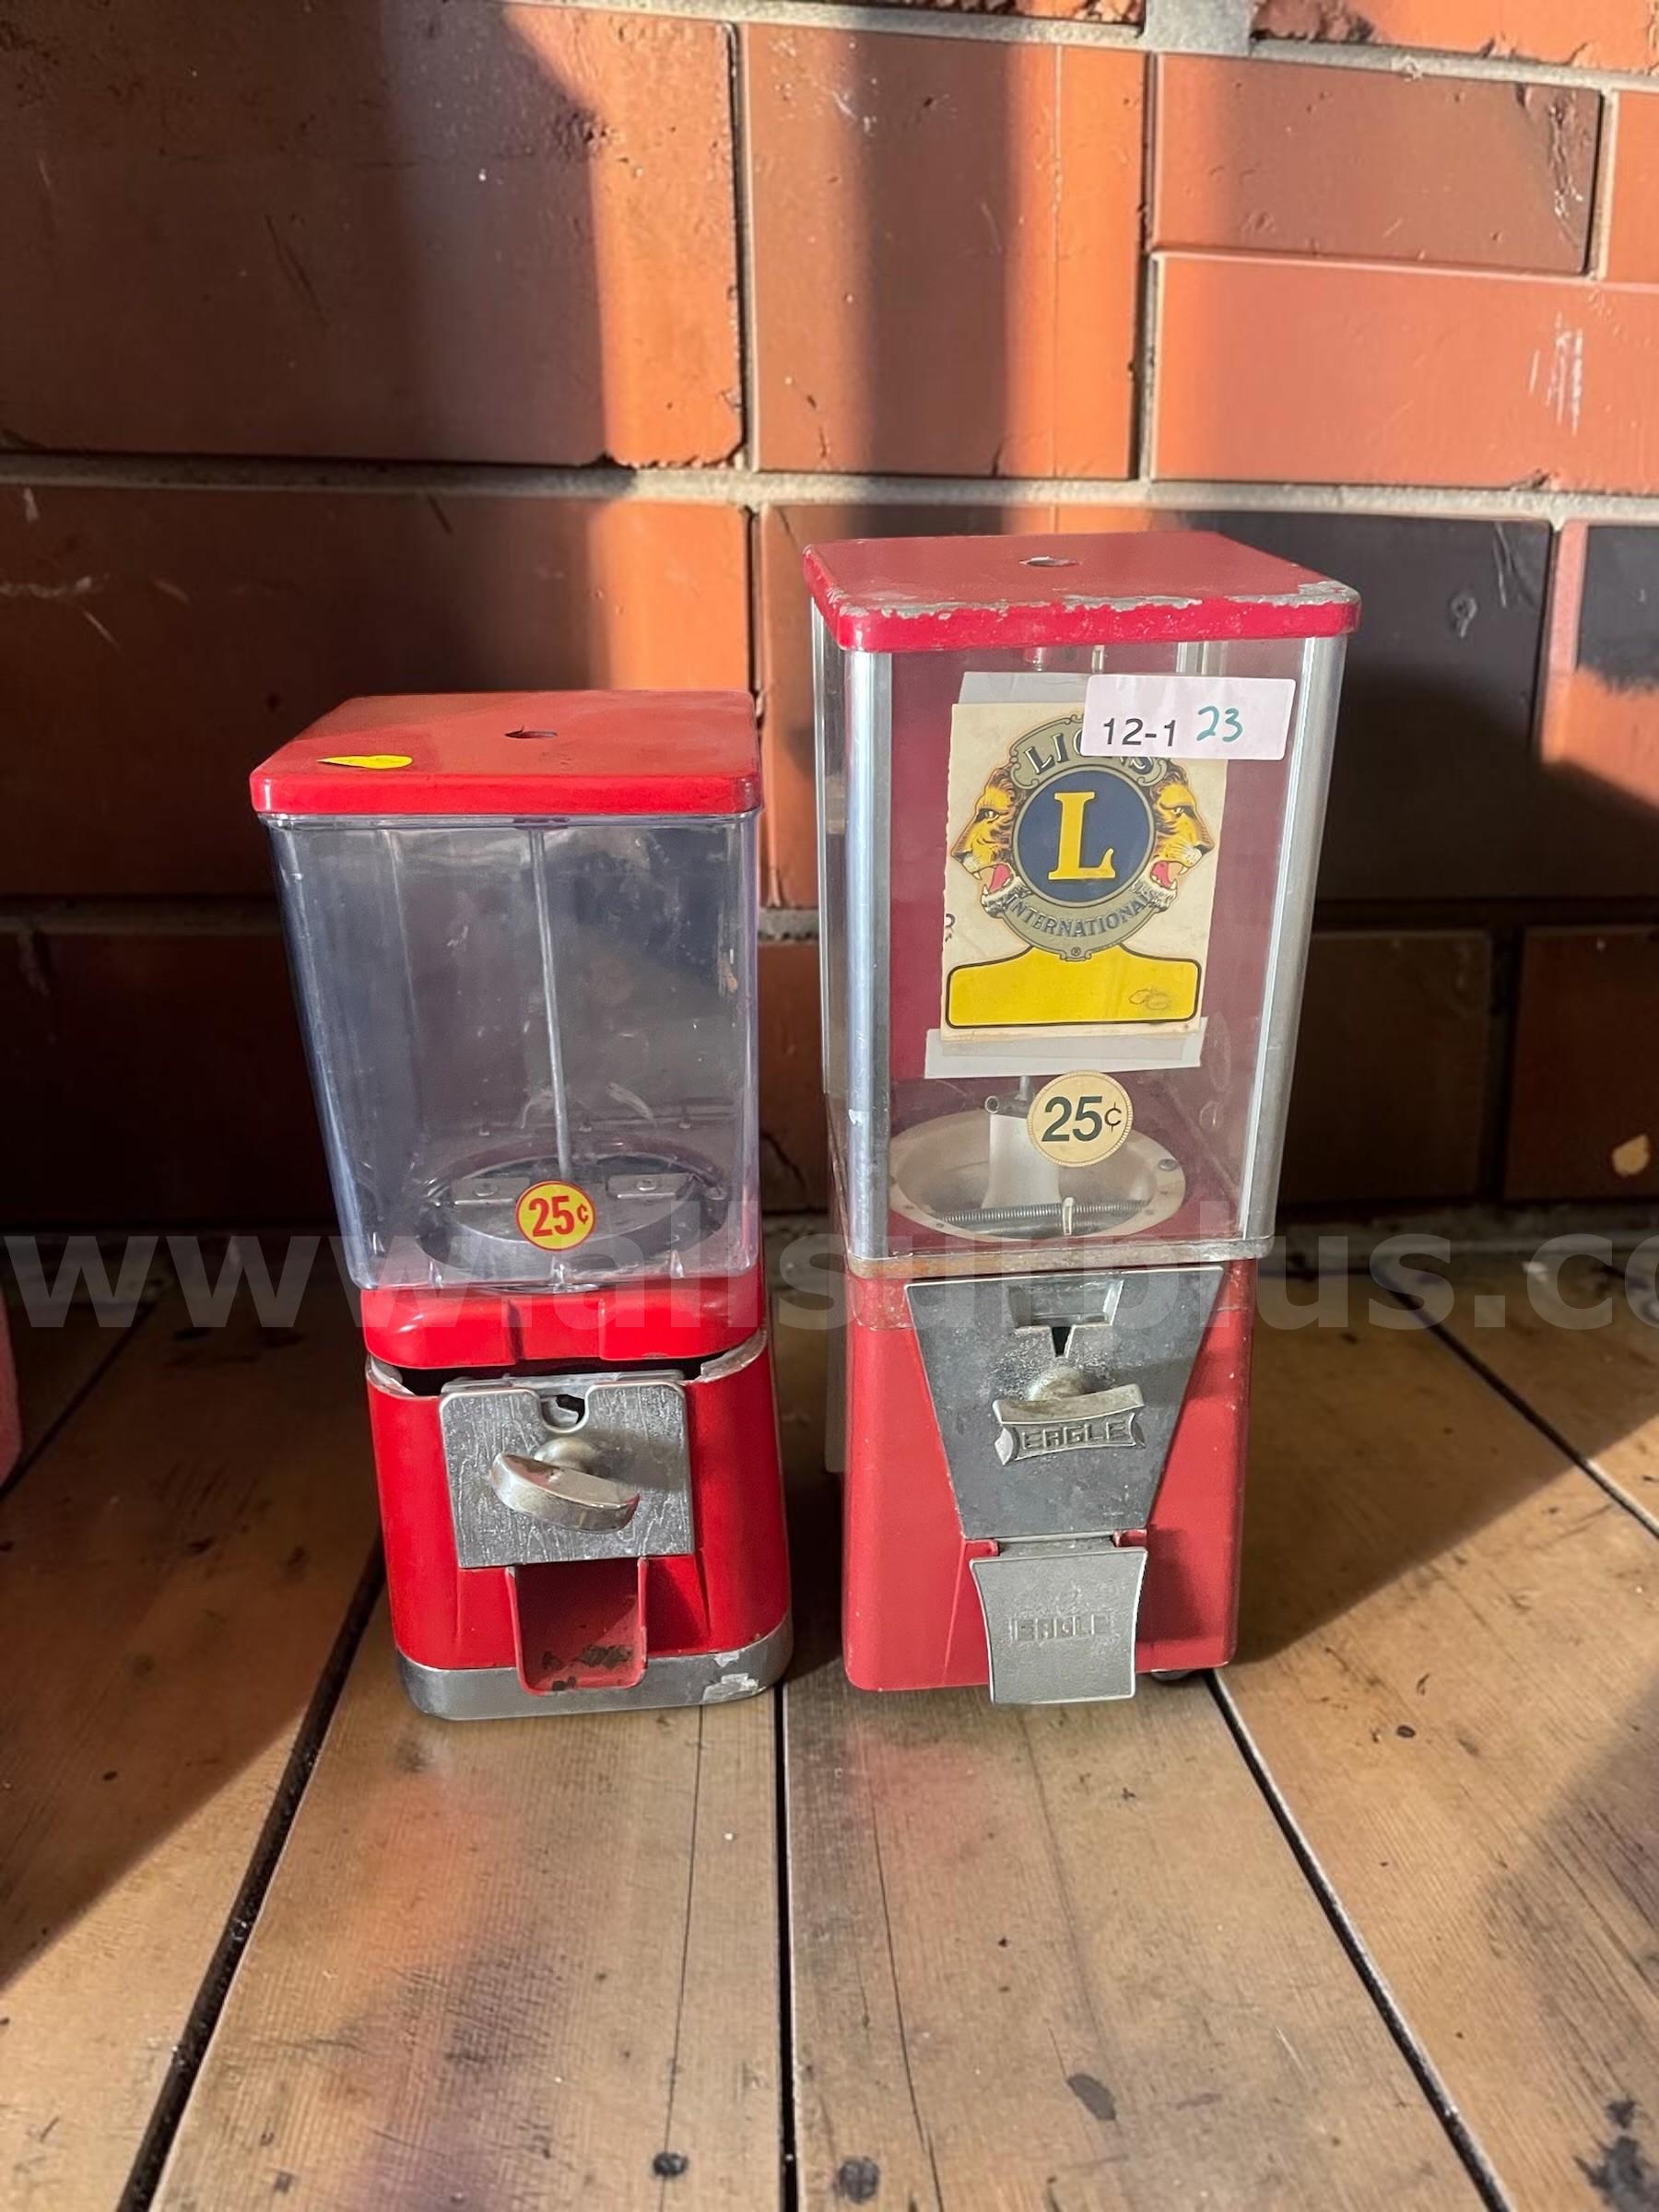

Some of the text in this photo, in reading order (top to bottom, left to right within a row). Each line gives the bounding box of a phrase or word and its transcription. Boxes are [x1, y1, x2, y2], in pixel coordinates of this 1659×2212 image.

[1103, 718, 1176, 747] 12-1
[1196, 705, 1243, 743] 23
[1024, 728, 1154, 776] LIS
[1048, 790, 1116, 882] L
[1041, 1095, 1123, 1143] 25¢
[528, 1194, 589, 1238] 25¢
[1021, 1419, 1128, 1450] EAGLE
[1013, 1612, 1112, 1643] EAGLE
